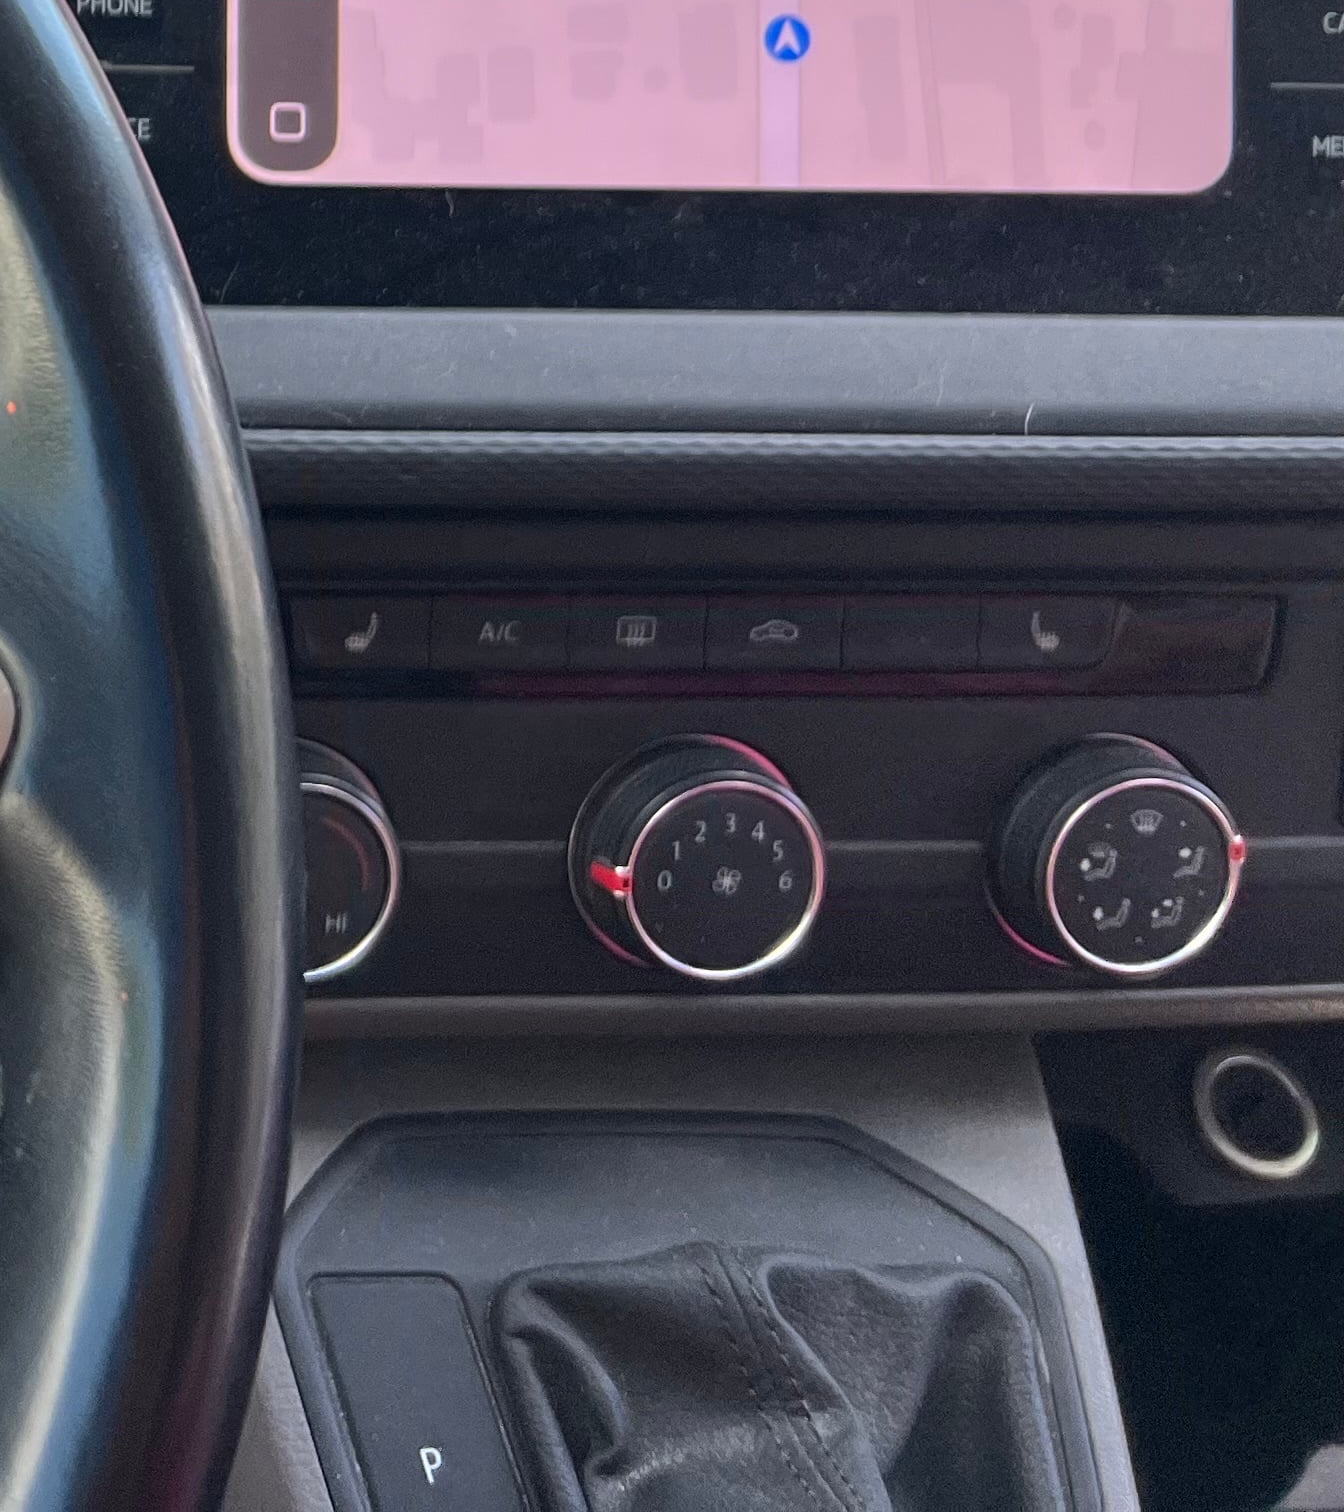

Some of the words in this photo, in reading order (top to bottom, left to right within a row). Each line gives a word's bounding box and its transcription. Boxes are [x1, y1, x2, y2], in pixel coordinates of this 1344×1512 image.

[479, 619, 521, 644] A/C
[695, 820, 707, 843] 2
[725, 812, 737, 834] 3
[751, 820, 765, 844] 4
[672, 840, 681, 862] 1
[772, 839, 784, 862] 5
[656, 869, 673, 892] 0
[778, 870, 794, 893] 6
[420, 1446, 442, 1484] P
